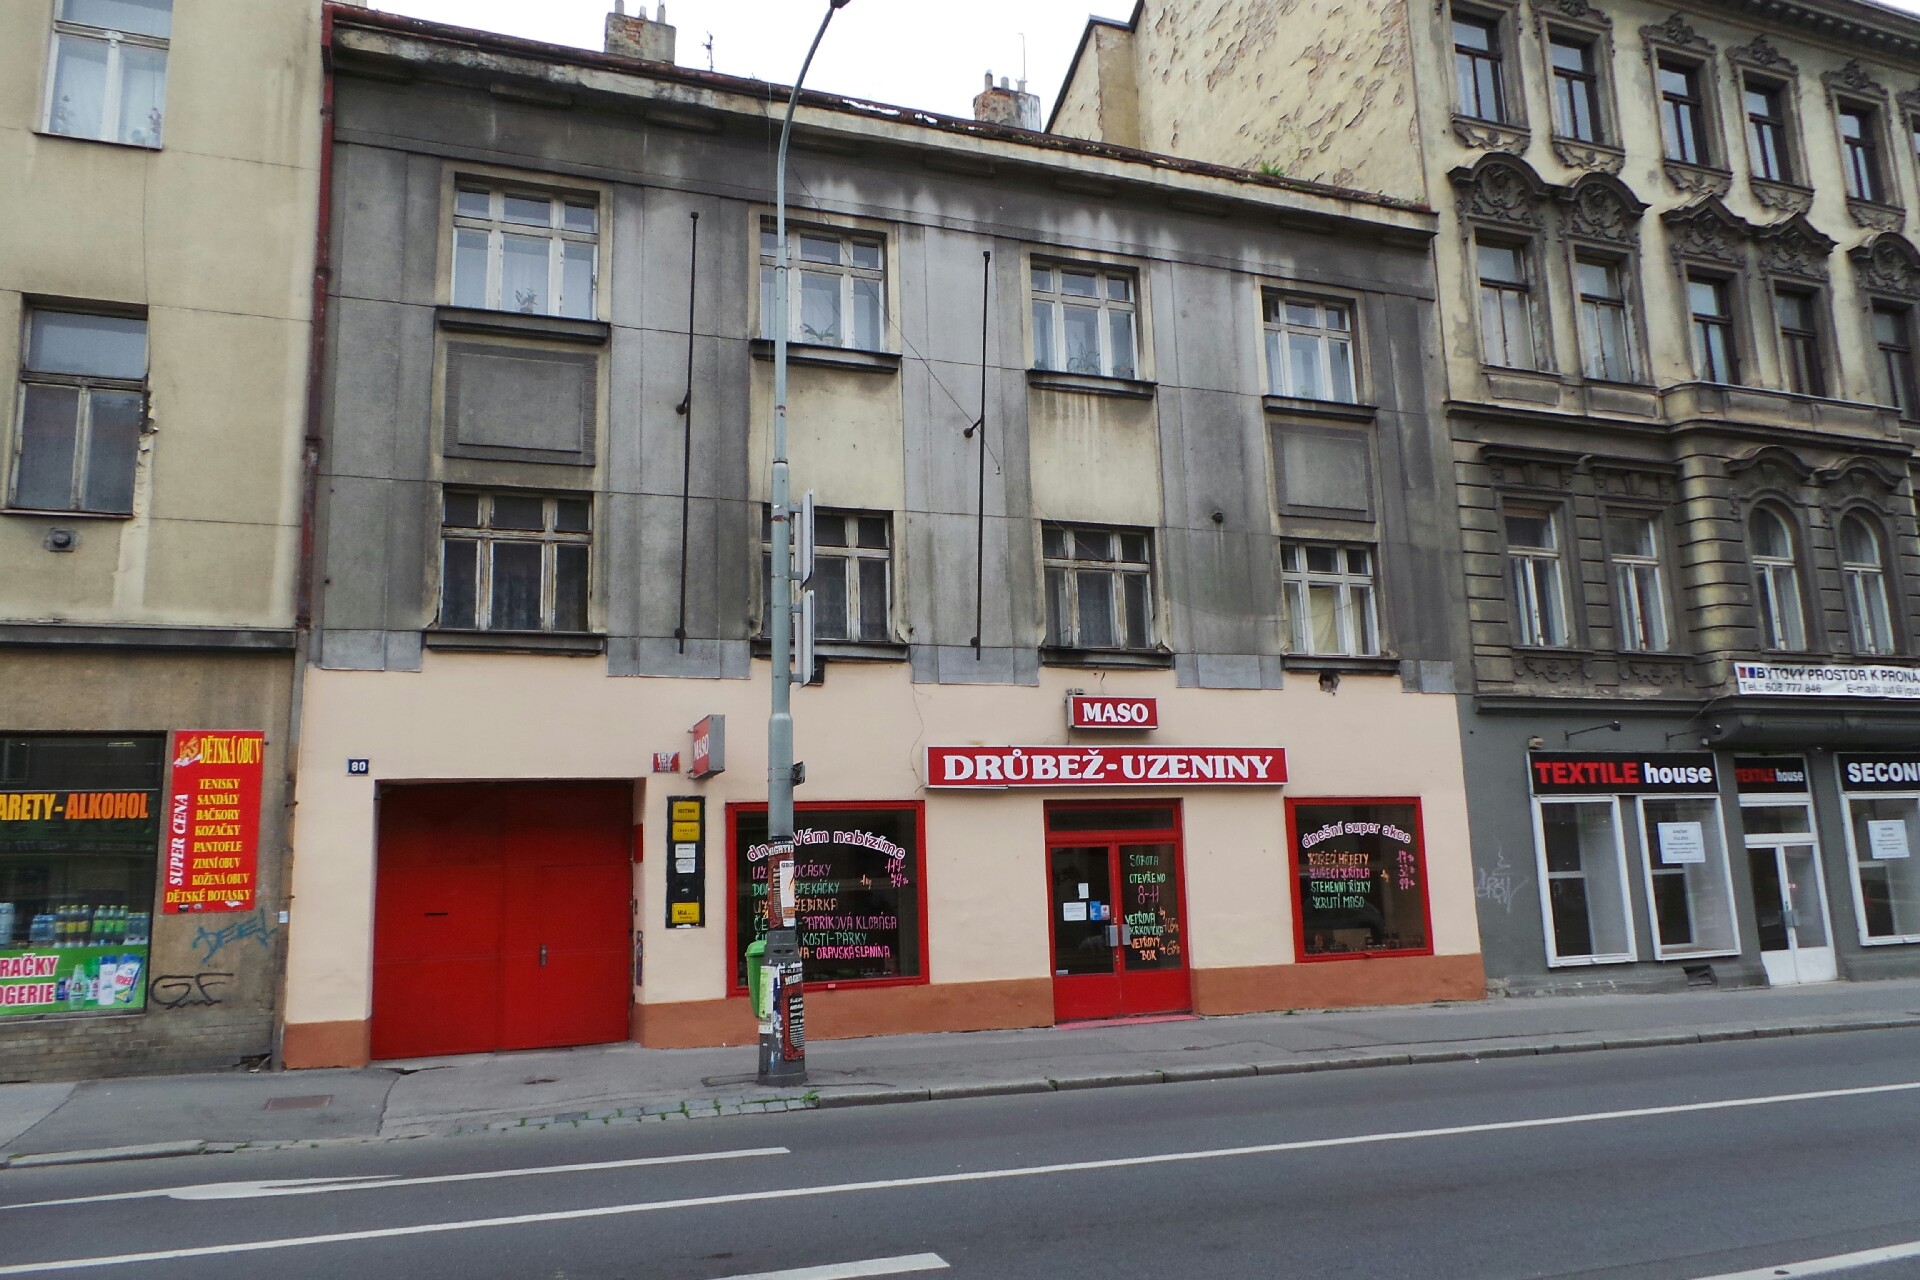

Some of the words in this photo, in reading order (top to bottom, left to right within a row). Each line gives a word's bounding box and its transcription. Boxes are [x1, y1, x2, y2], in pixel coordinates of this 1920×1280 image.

[1757, 666, 1805, 680] BYTOVÝ
[1808, 667, 1867, 681] PROSTOR
[1870, 669, 1879, 680] K
[1765, 682, 1783, 692] 608
[1786, 683, 1801, 692] 777
[1805, 683, 1821, 693] 846
[1083, 702, 1149, 722] MASO
[199, 735, 237, 764] DĚTSKÁ
[237, 737, 262, 764] OBUV
[351, 761, 366, 771] 80
[943, 748, 1273, 780] DRŮBEŽ-UZENINY
[1535, 762, 1640, 784] TEXTILE
[1644, 762, 1712, 784] house
[1775, 768, 1804, 782] house
[1847, 762, 1920, 783] SECON
[199, 778, 240, 790] TENISKY
[197, 793, 240, 805] SANDÁLY
[172, 794, 189, 834] CENA
[195, 808, 240, 821] BAČKORY
[195, 823, 241, 836] KOZAČKY
[1302, 821, 1344, 848] dnešní
[1344, 822, 1380, 836] super
[1382, 824, 1411, 843] akce
[193, 841, 242, 853] PANTOFLE
[793, 828, 829, 846] Vám
[833, 829, 906, 859] nabízíme
[169, 837, 186, 886] SUPER
[193, 857, 218, 869] ZIMNÍ
[219, 857, 241, 868] OBUV
[1129, 855, 1159, 866] SOBOTA
[192, 872, 225, 885] KOŽENÁ
[227, 873, 250, 884] OBUV
[1129, 871, 1166, 883] OTEVŘENO
[166, 888, 205, 903] DĚTSKÉ
[207, 888, 251, 902] BOTASKY
[1138, 885, 1159, 904] 8-11
[1342, 896, 1365, 908] MASO
[1140, 950, 1157, 960] BOK
